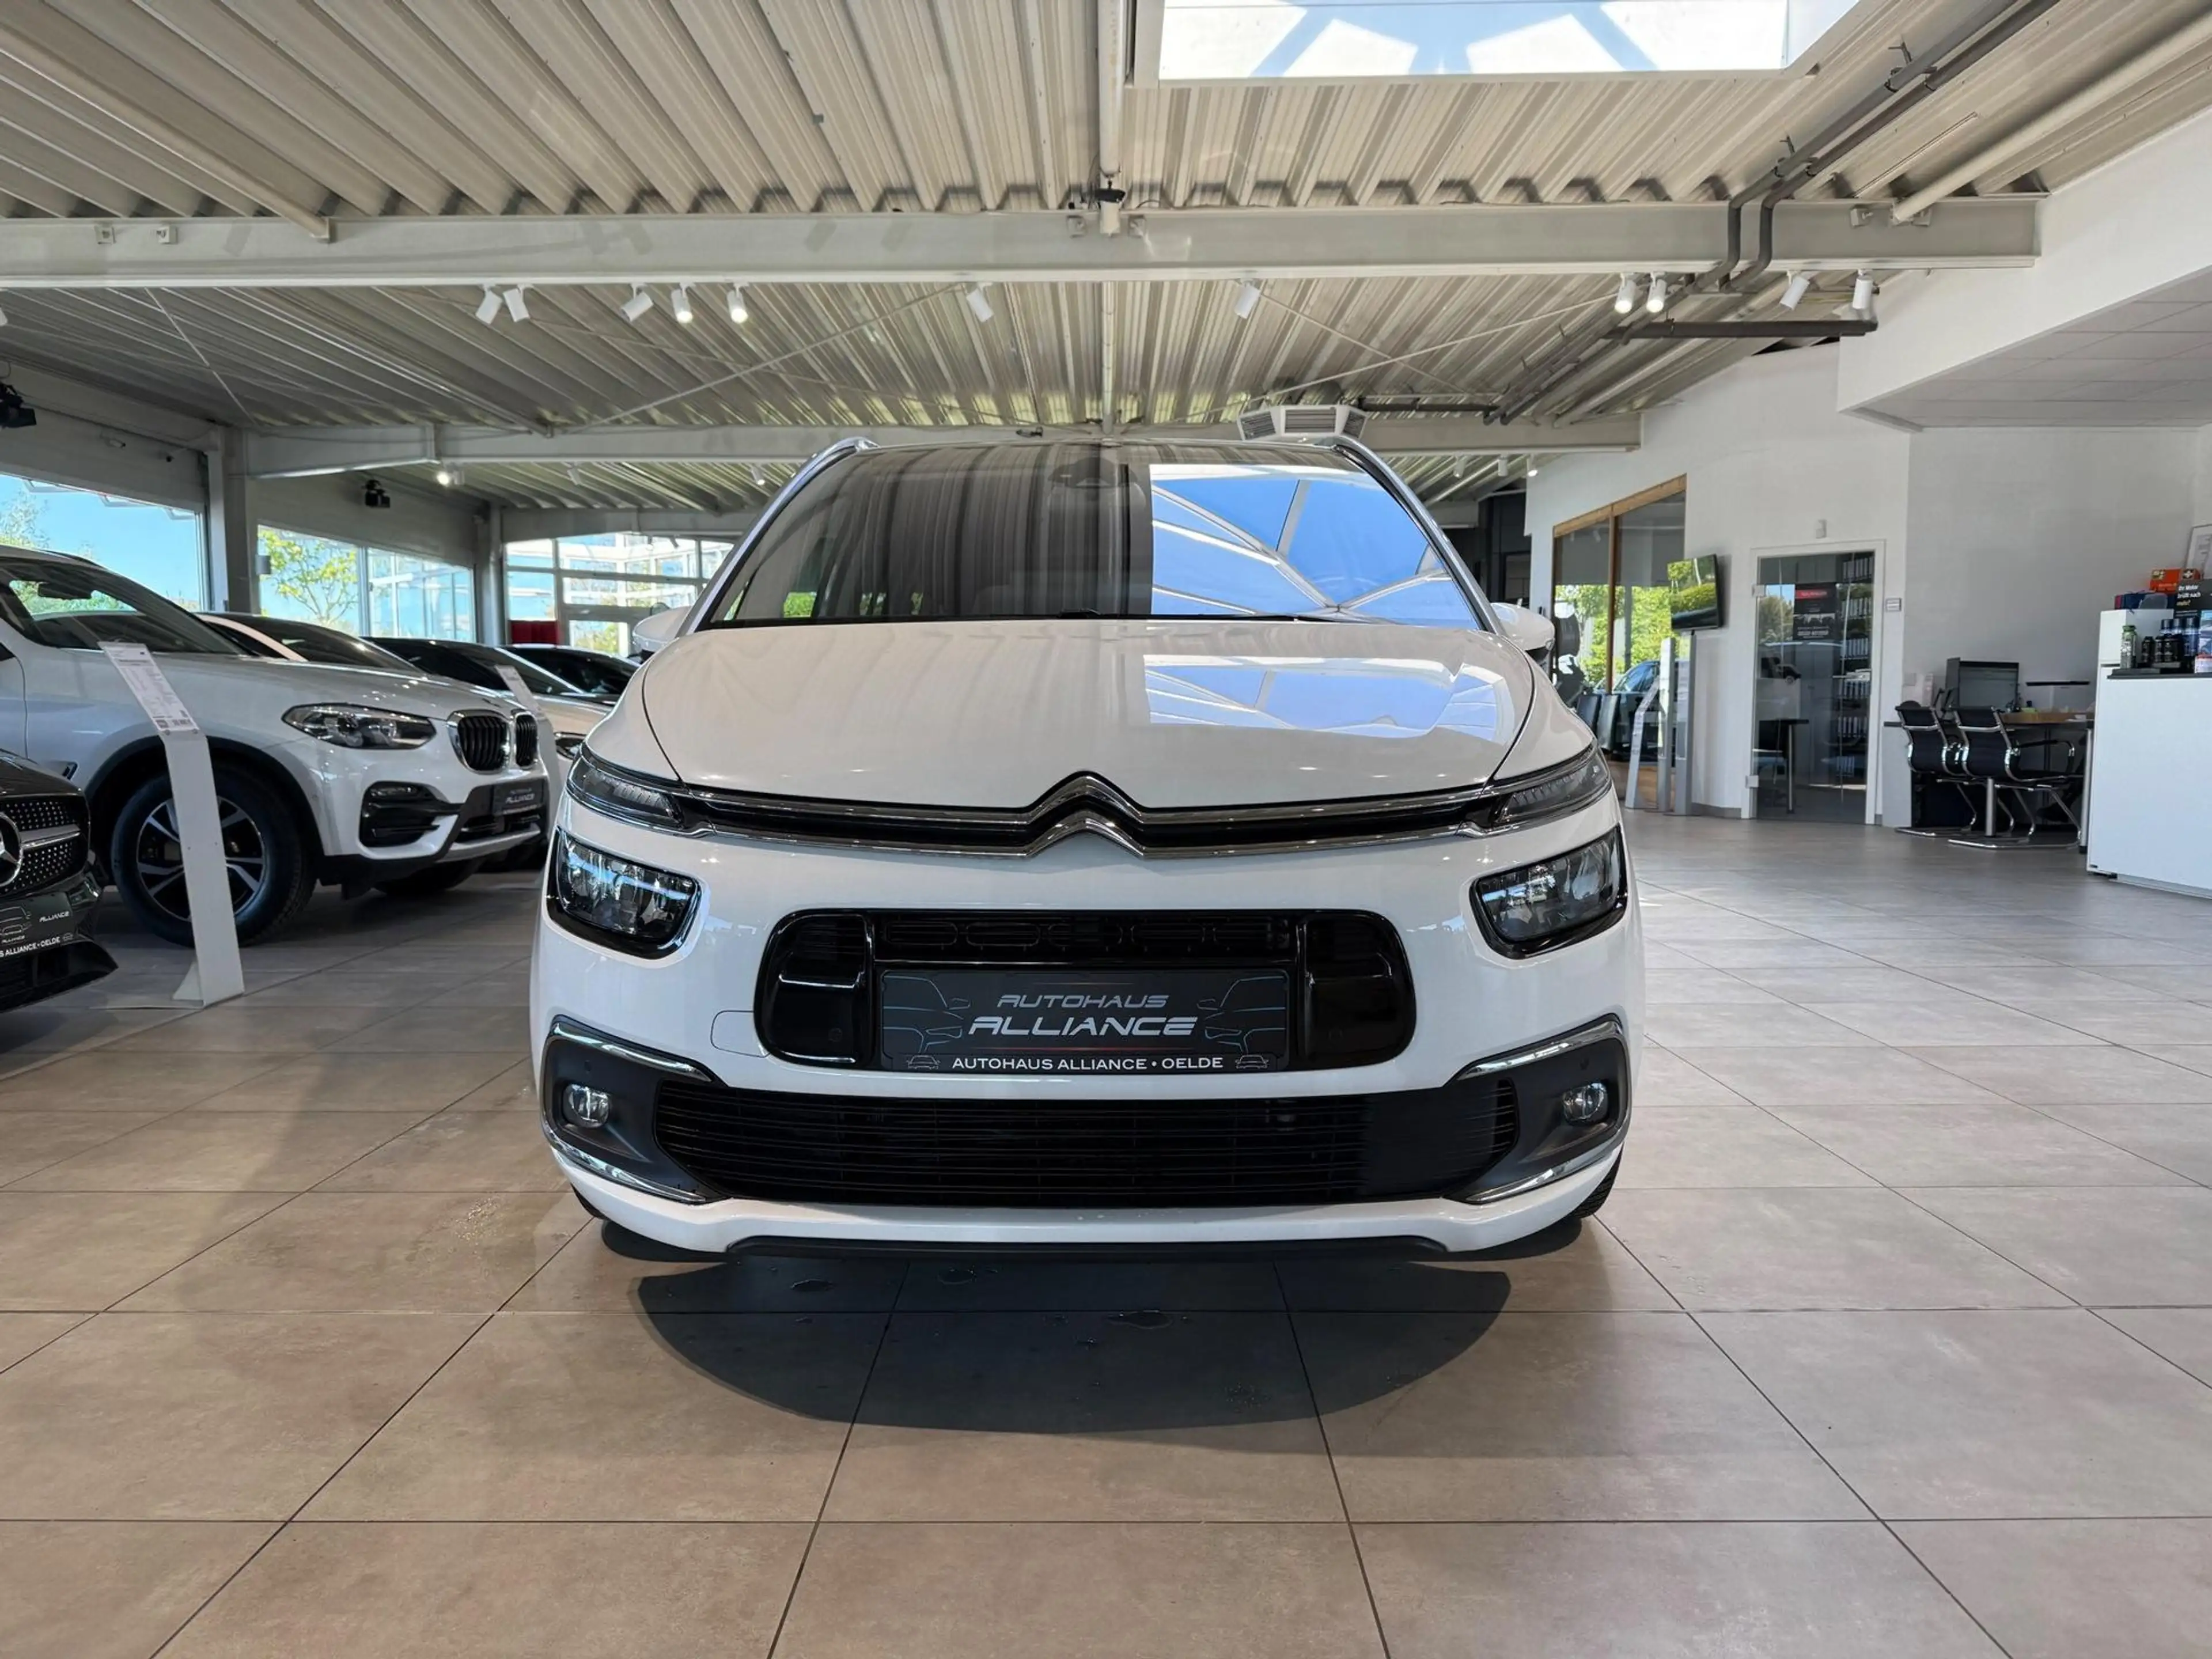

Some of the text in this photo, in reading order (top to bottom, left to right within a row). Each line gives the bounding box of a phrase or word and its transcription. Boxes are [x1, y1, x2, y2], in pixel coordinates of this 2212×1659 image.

[39, 911, 69, 922] ALLIANCE
[5, 942, 37, 956] ALLIANCE
[40, 937, 60, 948] OELDE
[997, 994, 1169, 1008] AUTOHAUS
[968, 1016, 1198, 1036] ALLIANCE
[952, 1057, 1224, 1070] AUTOHAUS ALLIANCE OELDE
